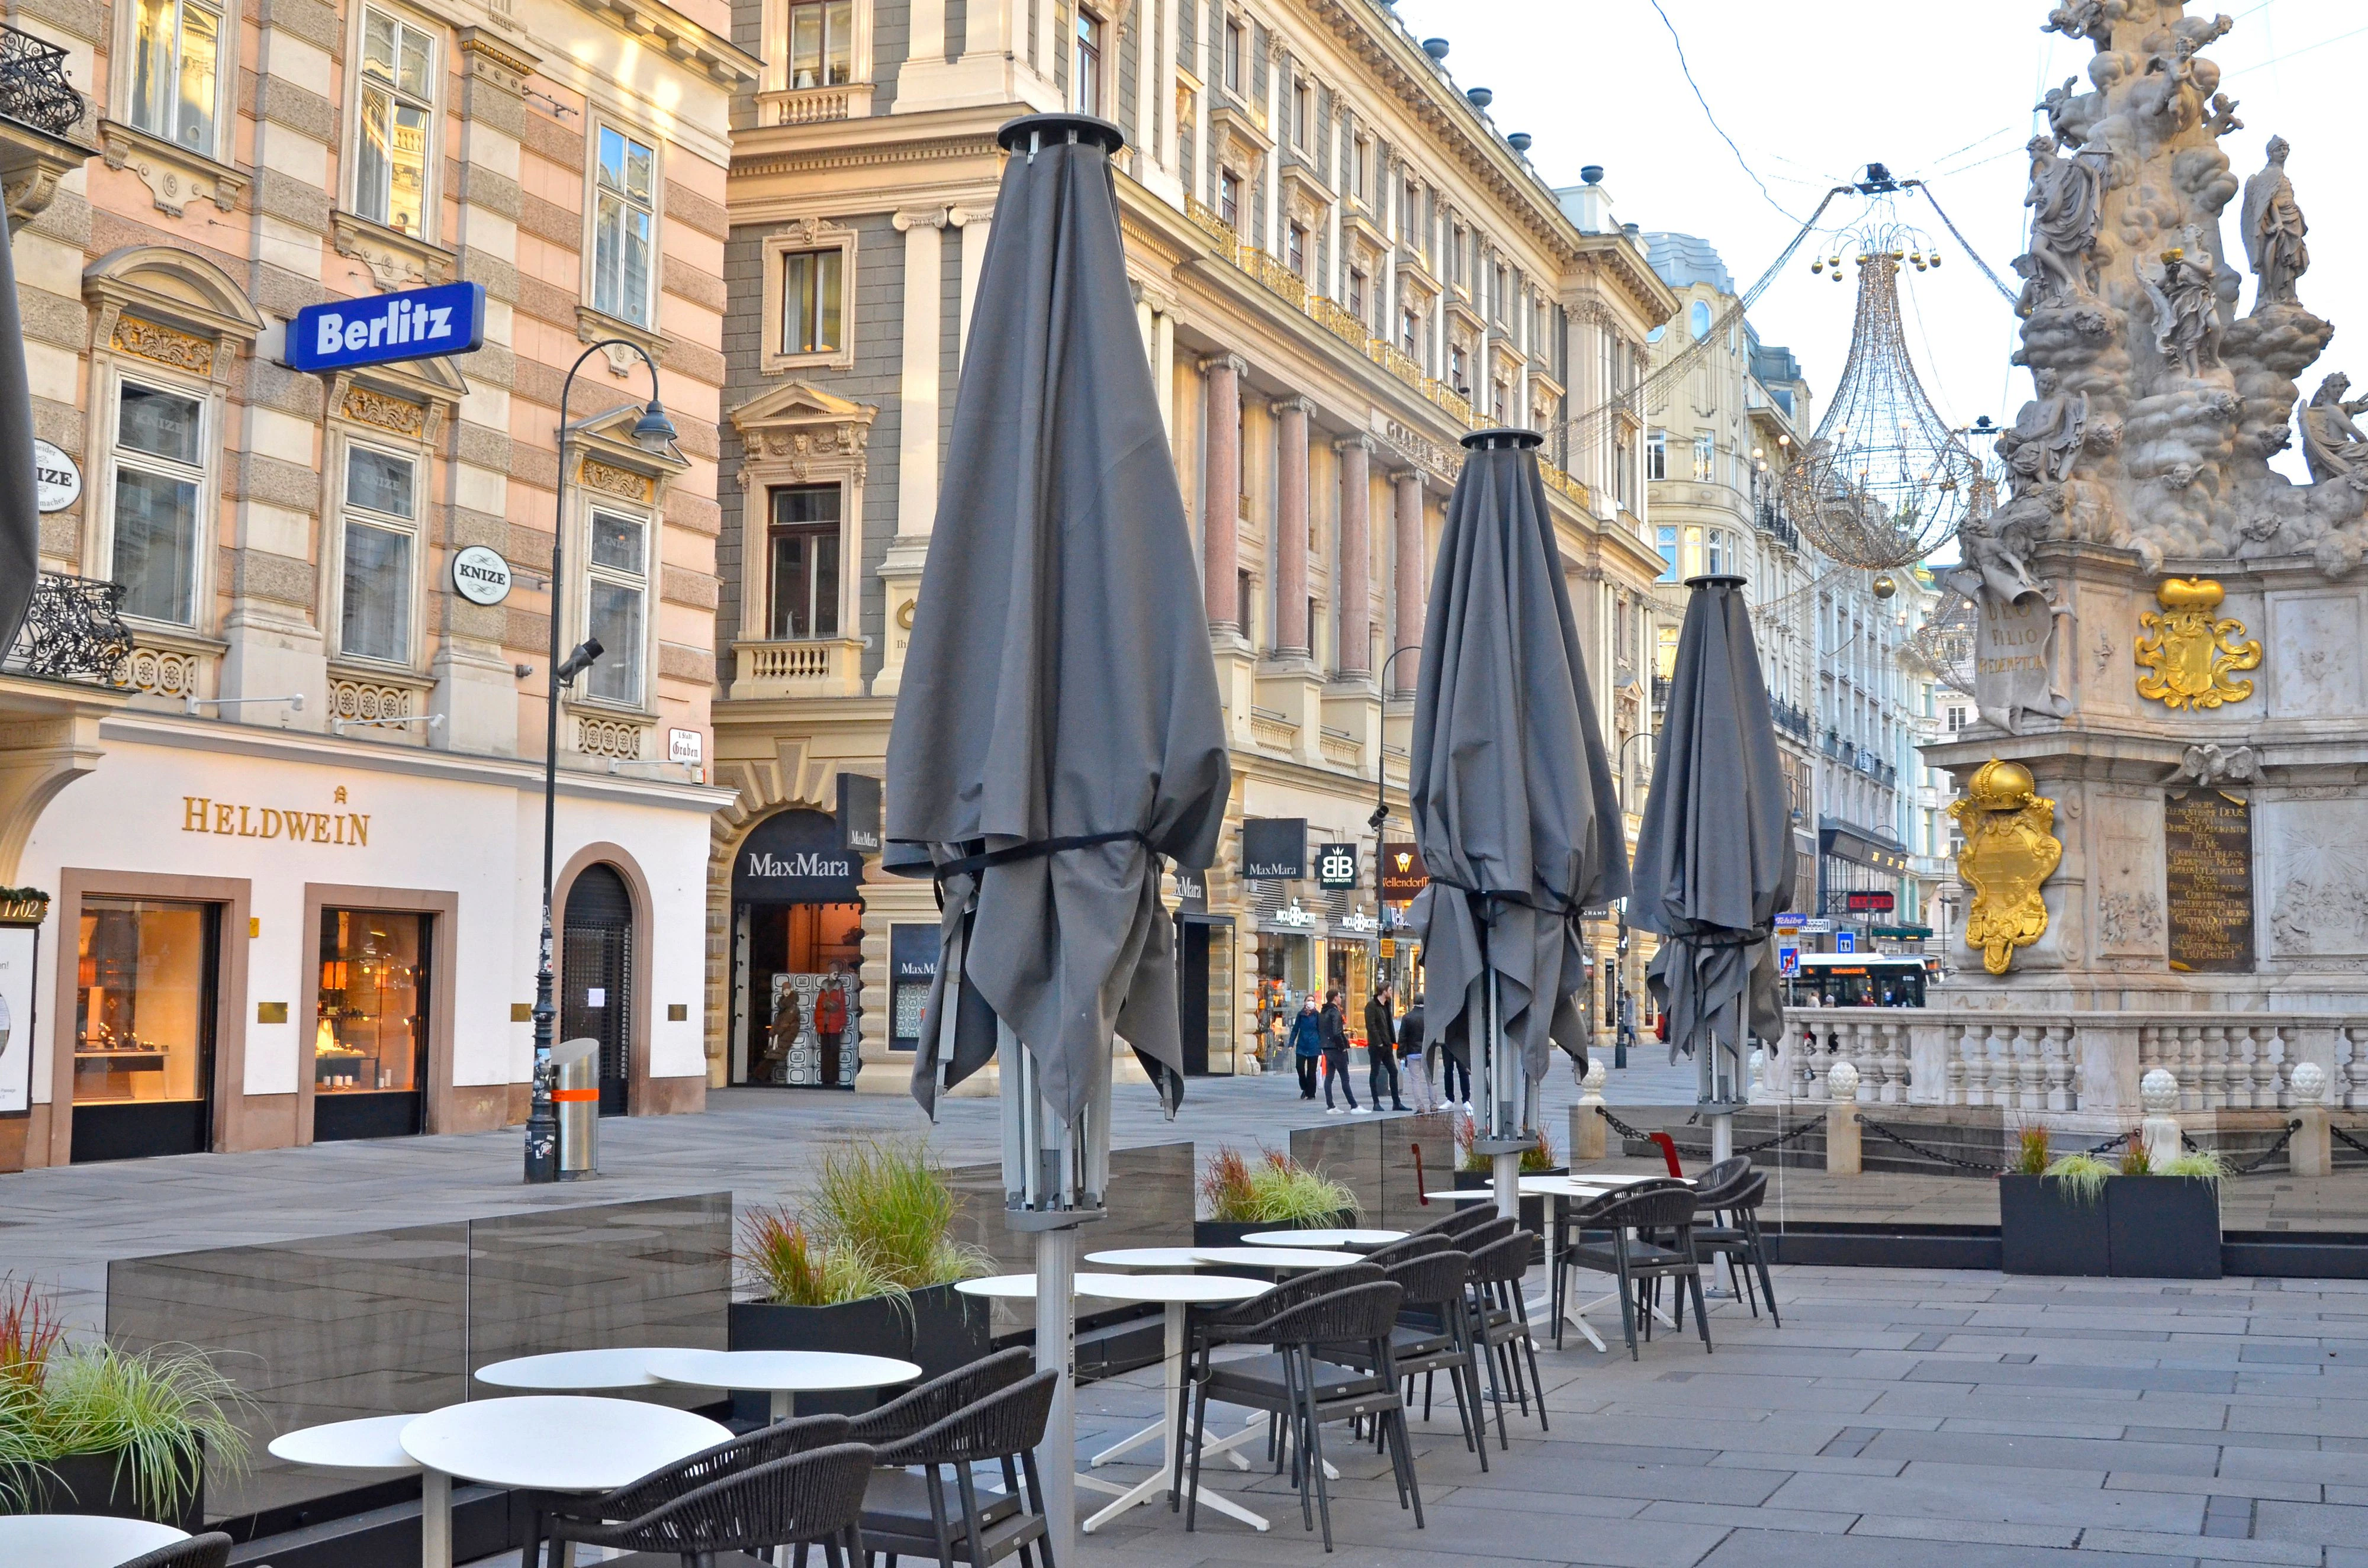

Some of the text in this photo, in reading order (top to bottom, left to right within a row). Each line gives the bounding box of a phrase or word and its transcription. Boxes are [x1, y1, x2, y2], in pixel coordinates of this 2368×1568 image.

[317, 298, 452, 355] Berlitz
[459, 564, 506, 585] KNIZE
[1987, 600, 2031, 621] DEO
[673, 741, 698, 758] Graben
[182, 796, 371, 846] HELDWEIN
[851, 830, 877, 847] MaxMara
[748, 853, 849, 877] MaxMara
[1249, 863, 1296, 875] MaxMara
